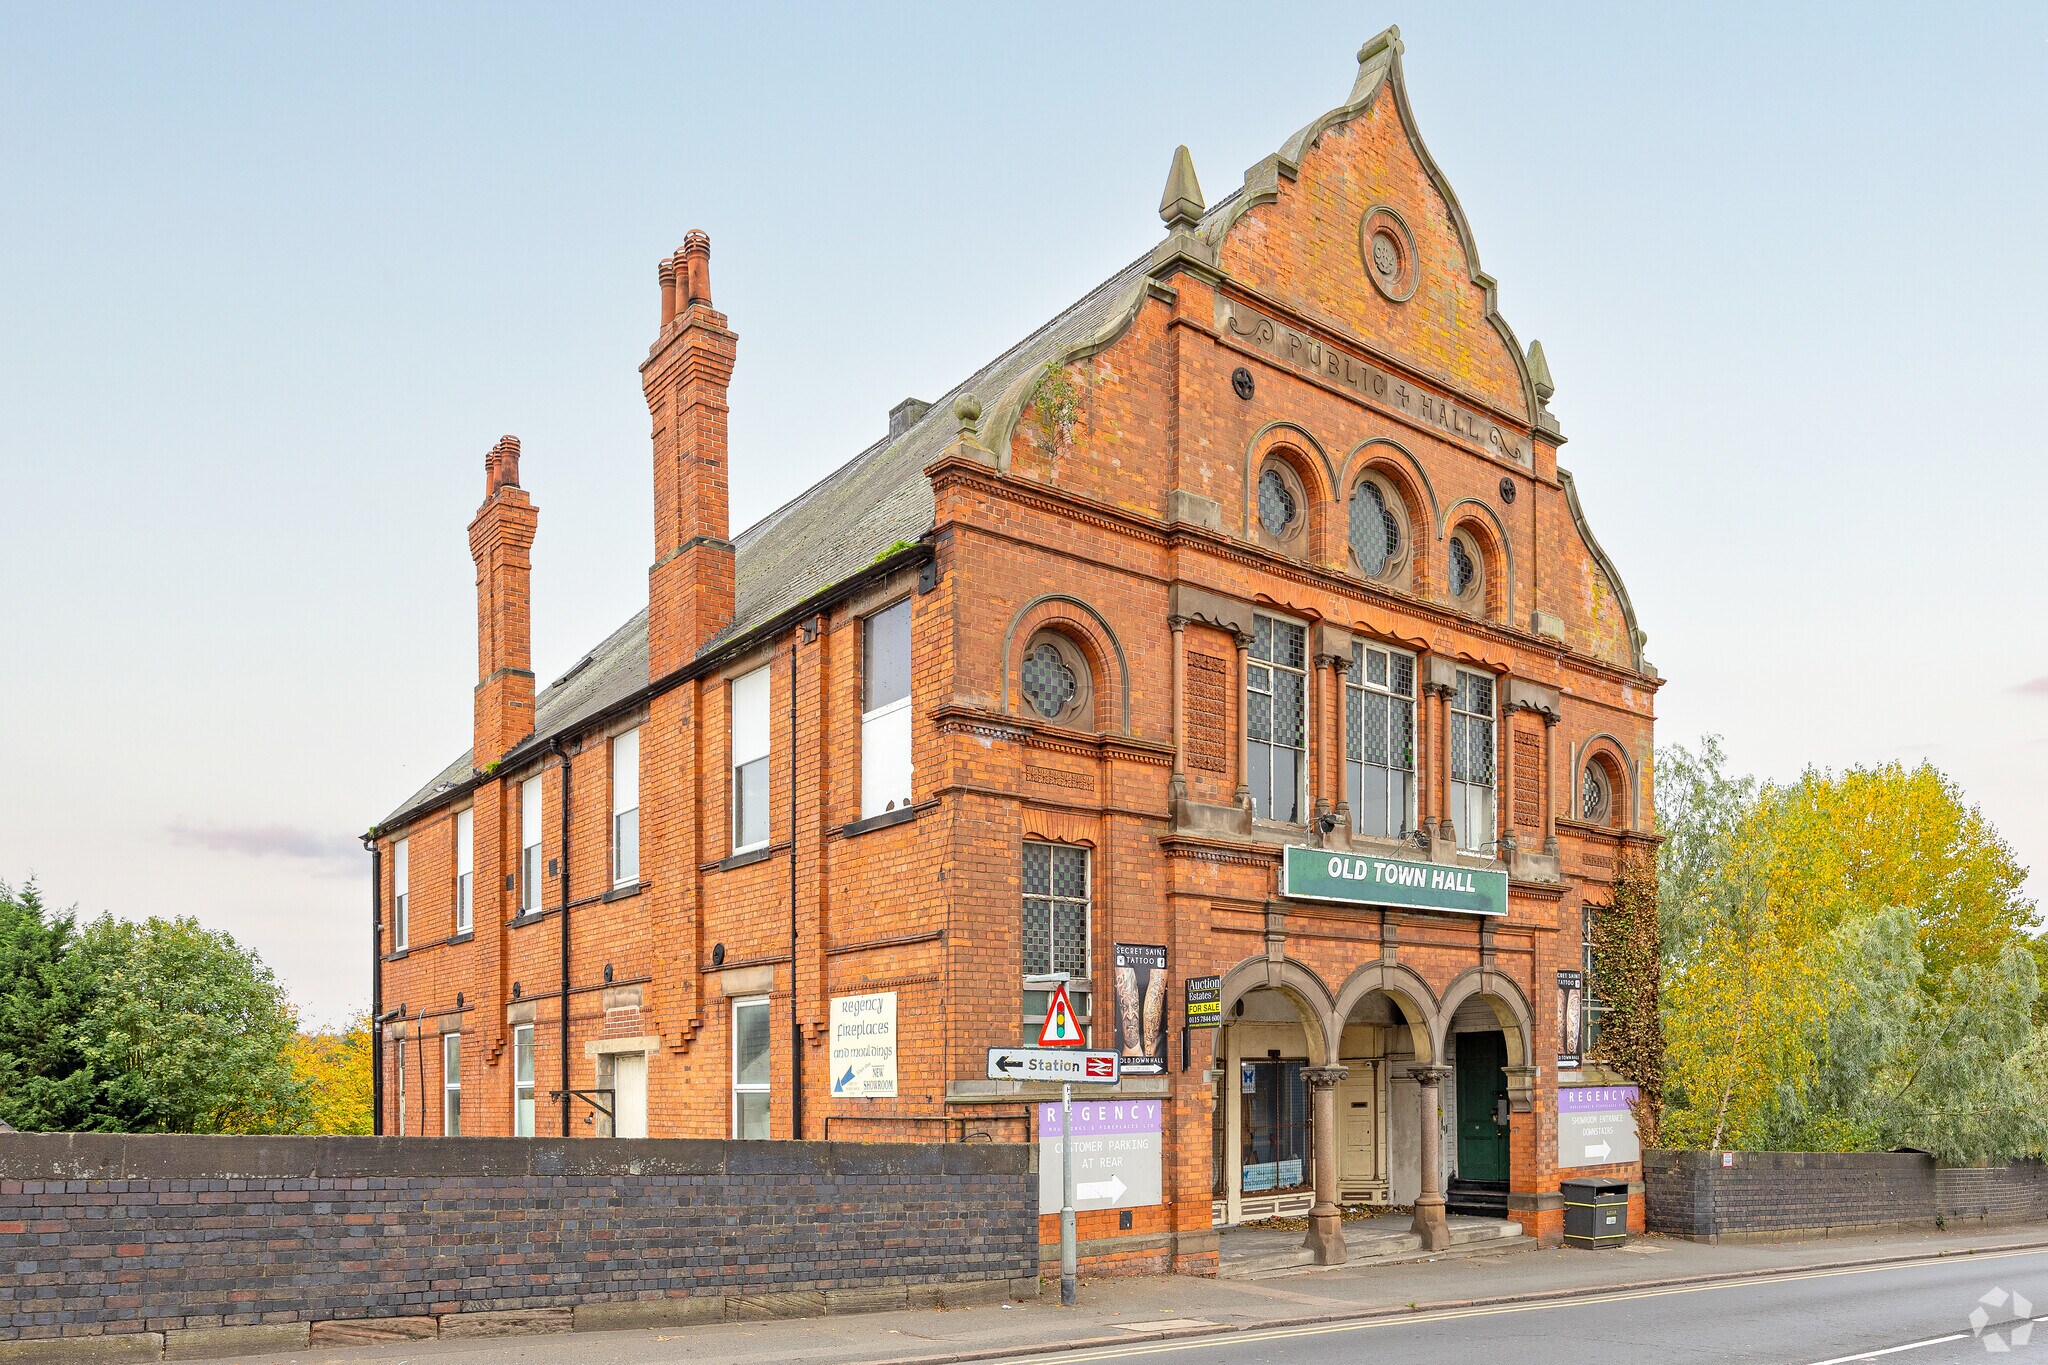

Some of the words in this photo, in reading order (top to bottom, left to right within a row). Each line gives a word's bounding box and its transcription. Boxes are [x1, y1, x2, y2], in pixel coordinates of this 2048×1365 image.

[1287, 331, 1386, 398] PUBLIC
[1420, 393, 1480, 441] HALL
[1327, 856, 1368, 881] OLD
[1373, 862, 1427, 888] TOWN
[1431, 869, 1476, 893] HALL
[1116, 946, 1142, 955] SECRET
[1145, 948, 1166, 956] SAINT
[1126, 956, 1155, 965] TATTOO
[1189, 977, 1220, 991] Auction
[1188, 991, 1212, 1001] Estates
[1189, 1004, 1202, 1013] FOR
[1203, 1003, 1220, 1012] SALE
[1188, 1016, 1200, 1024] 0115
[833, 1047, 850, 1059] and
[850, 1044, 893, 1060] mouldings
[1028, 1058, 1080, 1073] Station
[872, 1068, 884, 1078] NEW
[863, 1080, 894, 1091] SHOWROOM
[1569, 1090, 1626, 1103] REGENCY
[1571, 1115, 1598, 1125] SHOWROOM
[1599, 1114, 1624, 1123] ENTRANCE
[1582, 1126, 1614, 1136] DOWNSTAIRS
[1108, 1139, 1149, 1152] PARKING
[1081, 1158, 1095, 1169] AT
[1100, 1156, 1123, 1168] REAR
